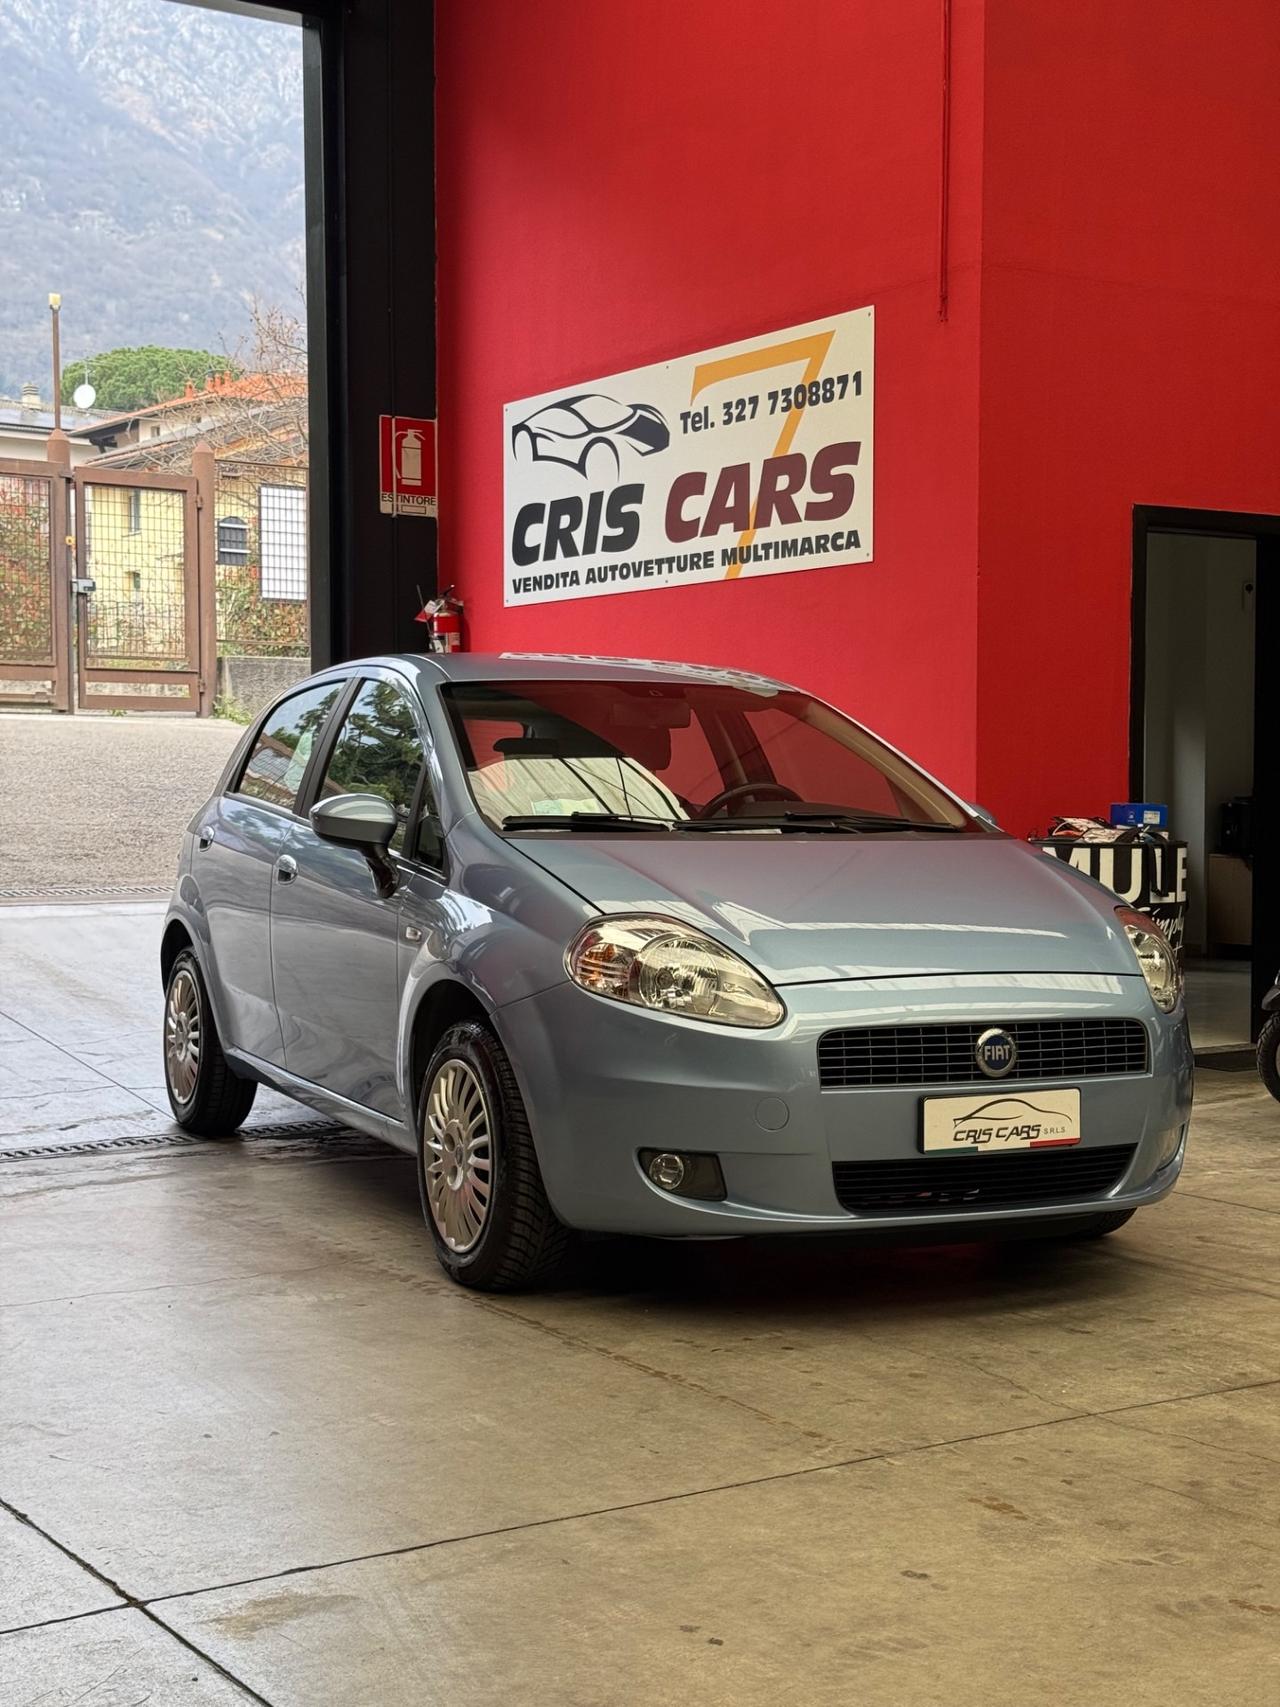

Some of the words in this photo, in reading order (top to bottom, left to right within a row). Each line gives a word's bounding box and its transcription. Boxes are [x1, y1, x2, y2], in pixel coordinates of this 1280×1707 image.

[680, 407, 715, 434] Tel.
[722, 395, 760, 426] 327
[768, 370, 862, 415] 7308871
[512, 483, 645, 567] CRIS
[665, 441, 862, 543] CARS
[512, 570, 580, 594] VENDITA
[585, 550, 715, 585] AUTOVETTURE
[720, 529, 862, 567] MULTIMARCA
[984, 1044, 1010, 1061] FIAT
[953, 1128, 994, 1145] CRIS
[995, 1124, 1042, 1142] CARS
